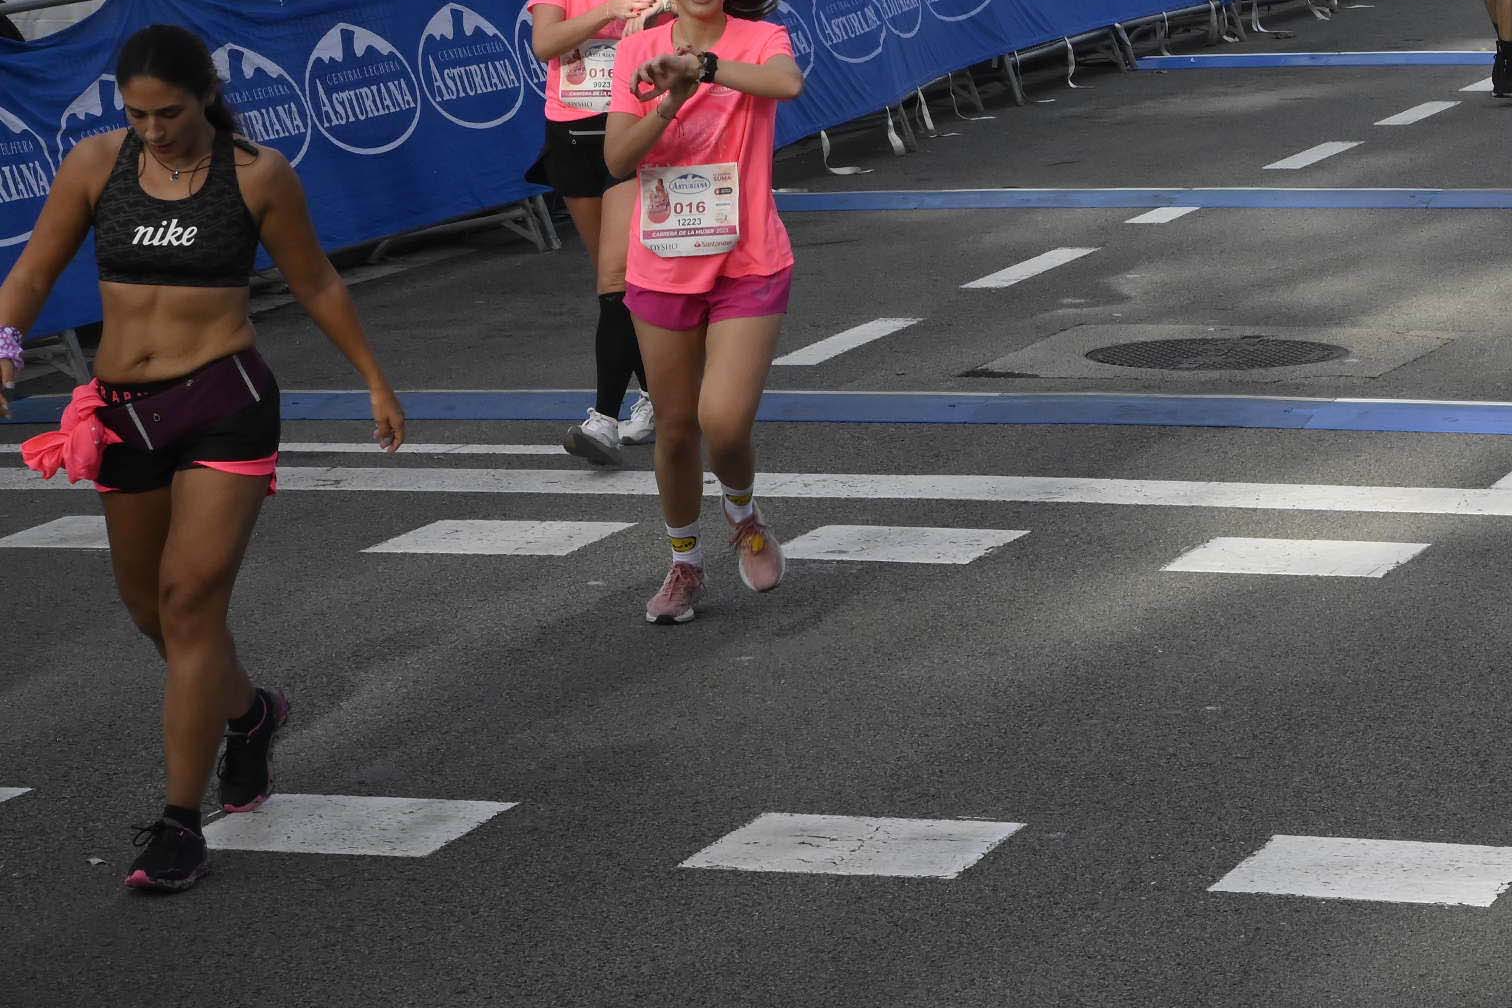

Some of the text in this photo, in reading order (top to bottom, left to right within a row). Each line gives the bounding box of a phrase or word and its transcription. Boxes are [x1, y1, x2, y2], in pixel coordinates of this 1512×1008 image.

[326, 68, 361, 87] CENTRAL
[429, 53, 521, 102] ASTURIANA
[316, 77, 417, 129] ASTURIANA
[674, 201, 706, 215] 016
[132, 218, 198, 247] nike
[678, 217, 703, 227] 12223
